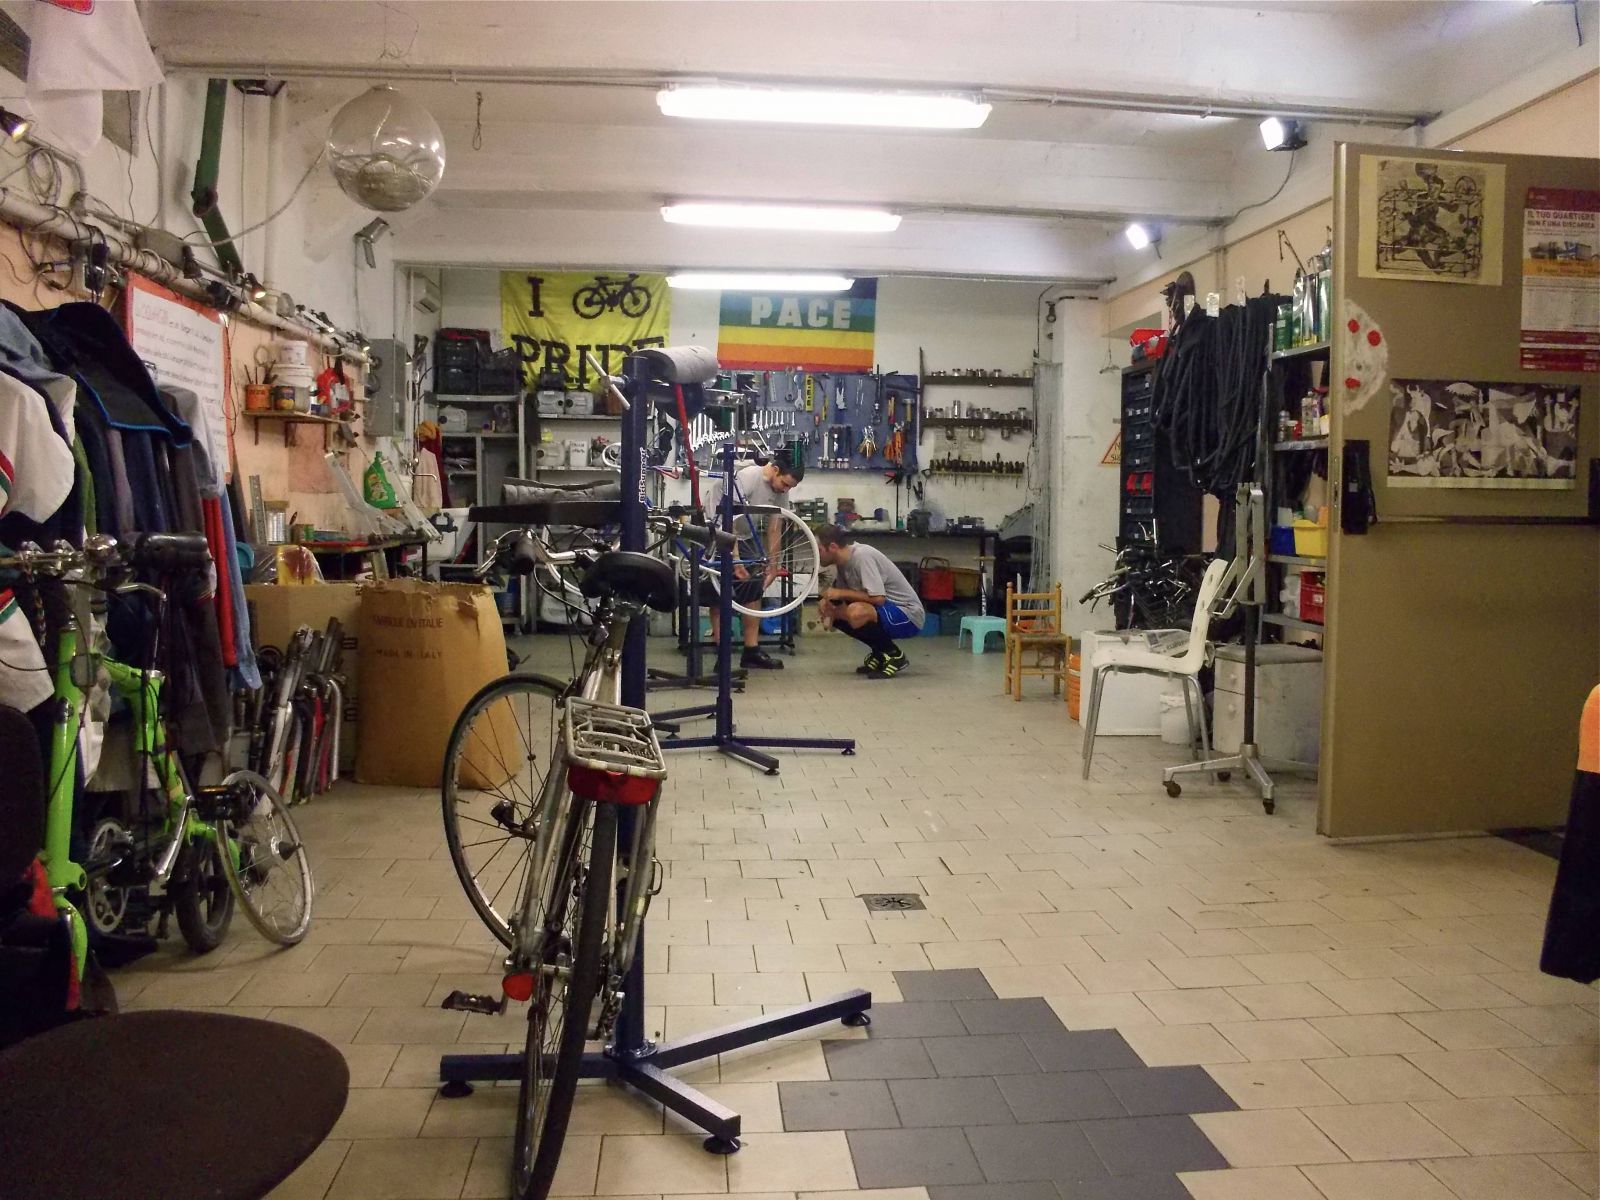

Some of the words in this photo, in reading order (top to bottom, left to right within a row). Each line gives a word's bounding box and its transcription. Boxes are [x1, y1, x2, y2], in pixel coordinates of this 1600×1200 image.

[1536, 211, 1551, 219] TUO
[1552, 211, 1596, 221] QUARTIERE
[527, 276, 545, 318] I
[751, 296, 851, 328] PACE
[511, 334, 665, 385] PRID
[418, 617, 444, 628] ITALIE
